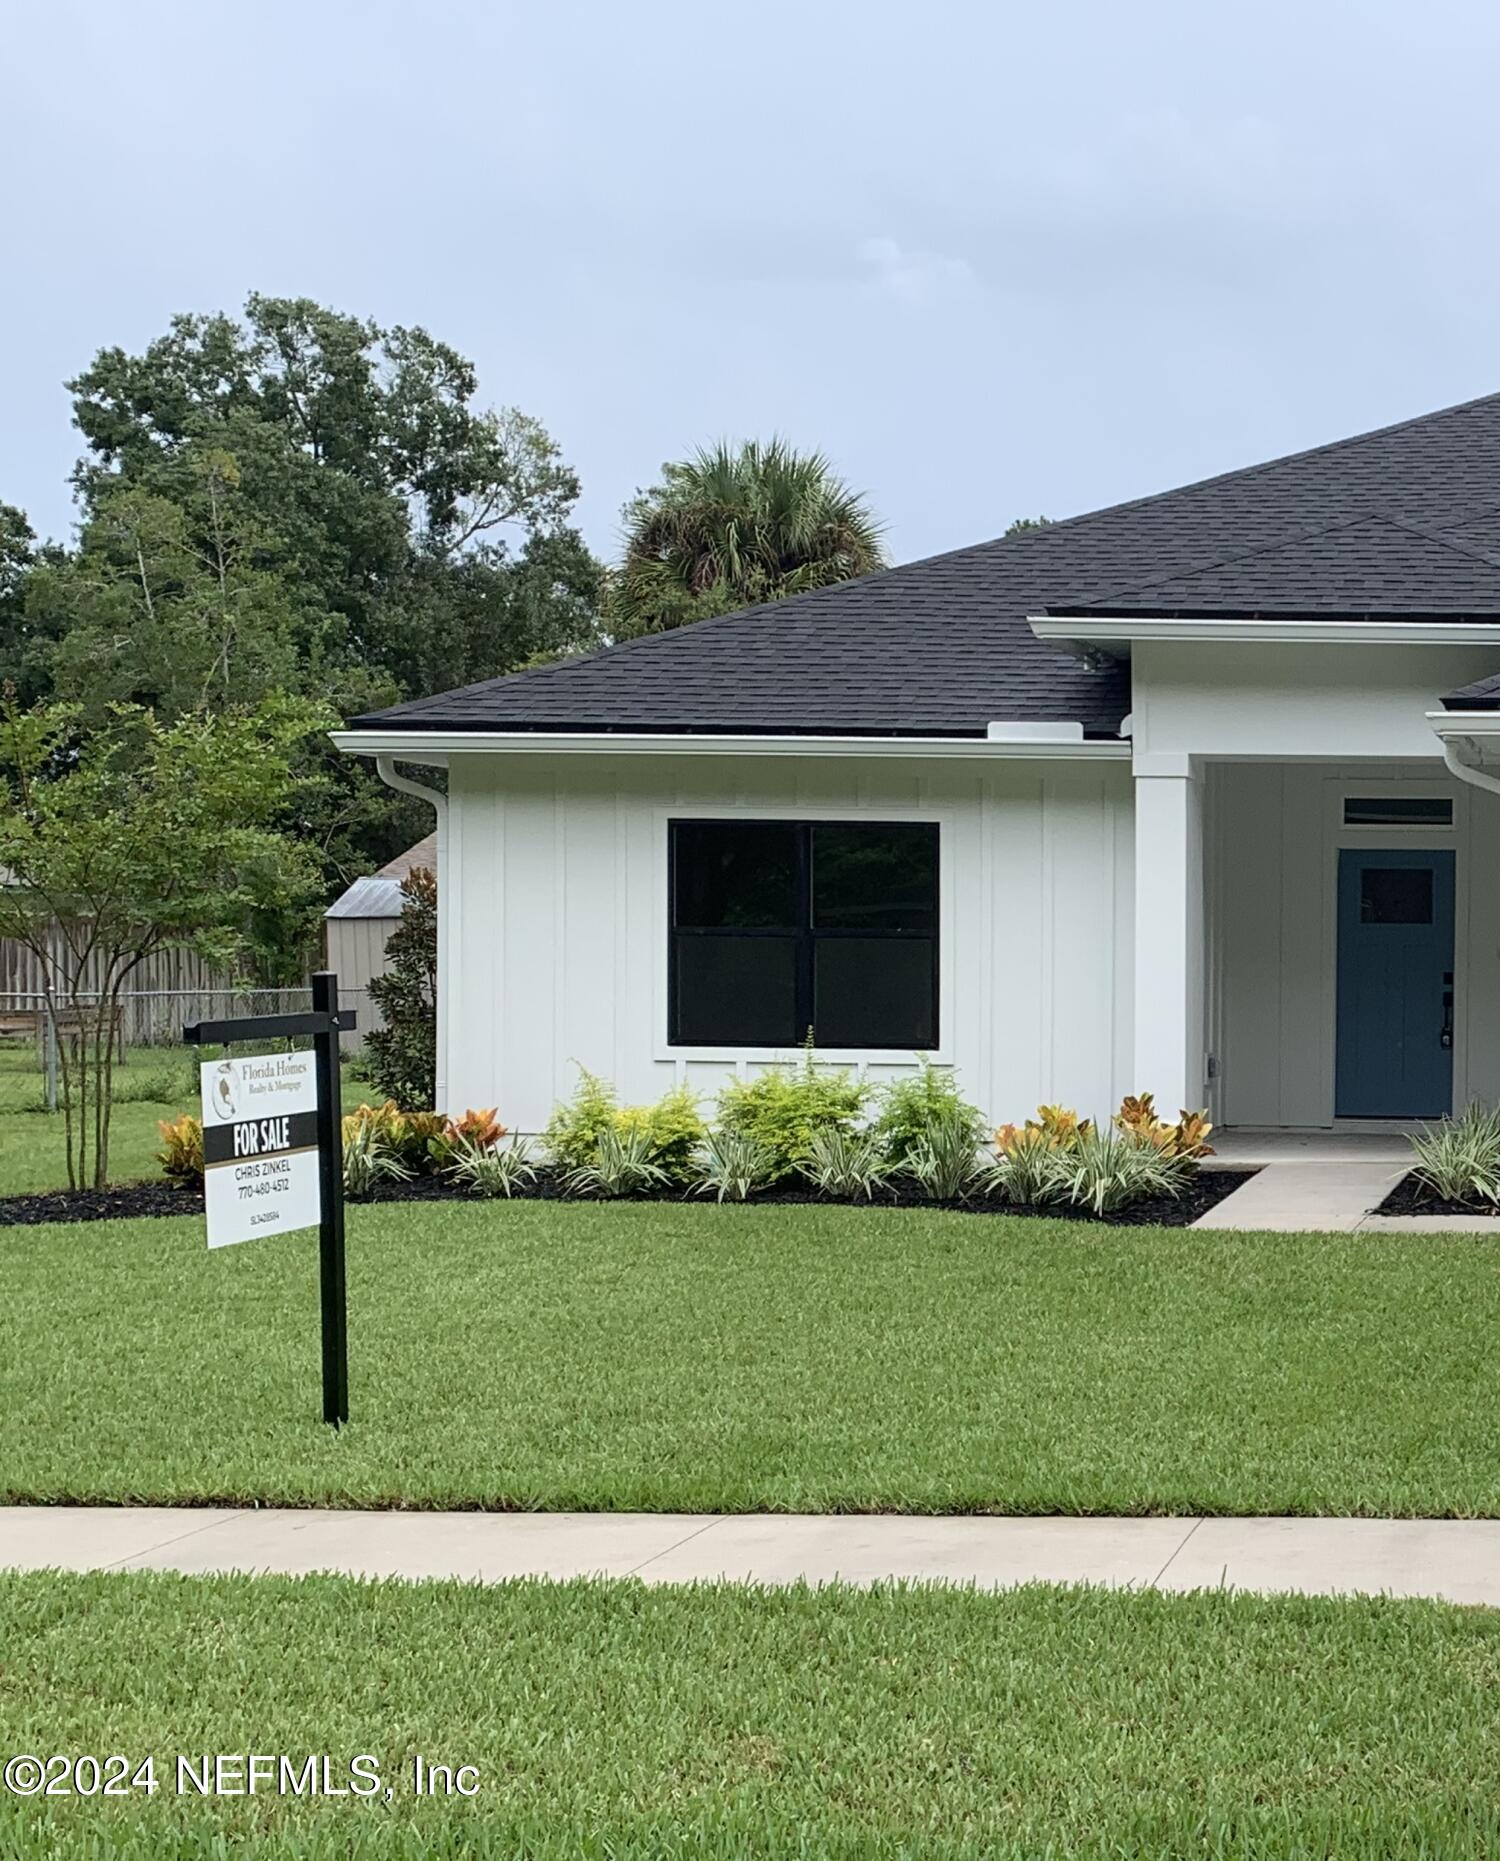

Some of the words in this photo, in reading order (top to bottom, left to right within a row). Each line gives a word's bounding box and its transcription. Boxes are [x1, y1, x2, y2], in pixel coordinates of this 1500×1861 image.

[242, 1061, 275, 1081] Florida
[277, 1060, 307, 1077] Homes
[234, 1122, 259, 1157] FOR
[260, 1117, 291, 1153] SALE
[235, 1164, 261, 1182] CHRIS
[262, 1159, 291, 1177] ZINKEL
[238, 1177, 289, 1200] 770-480-4512
